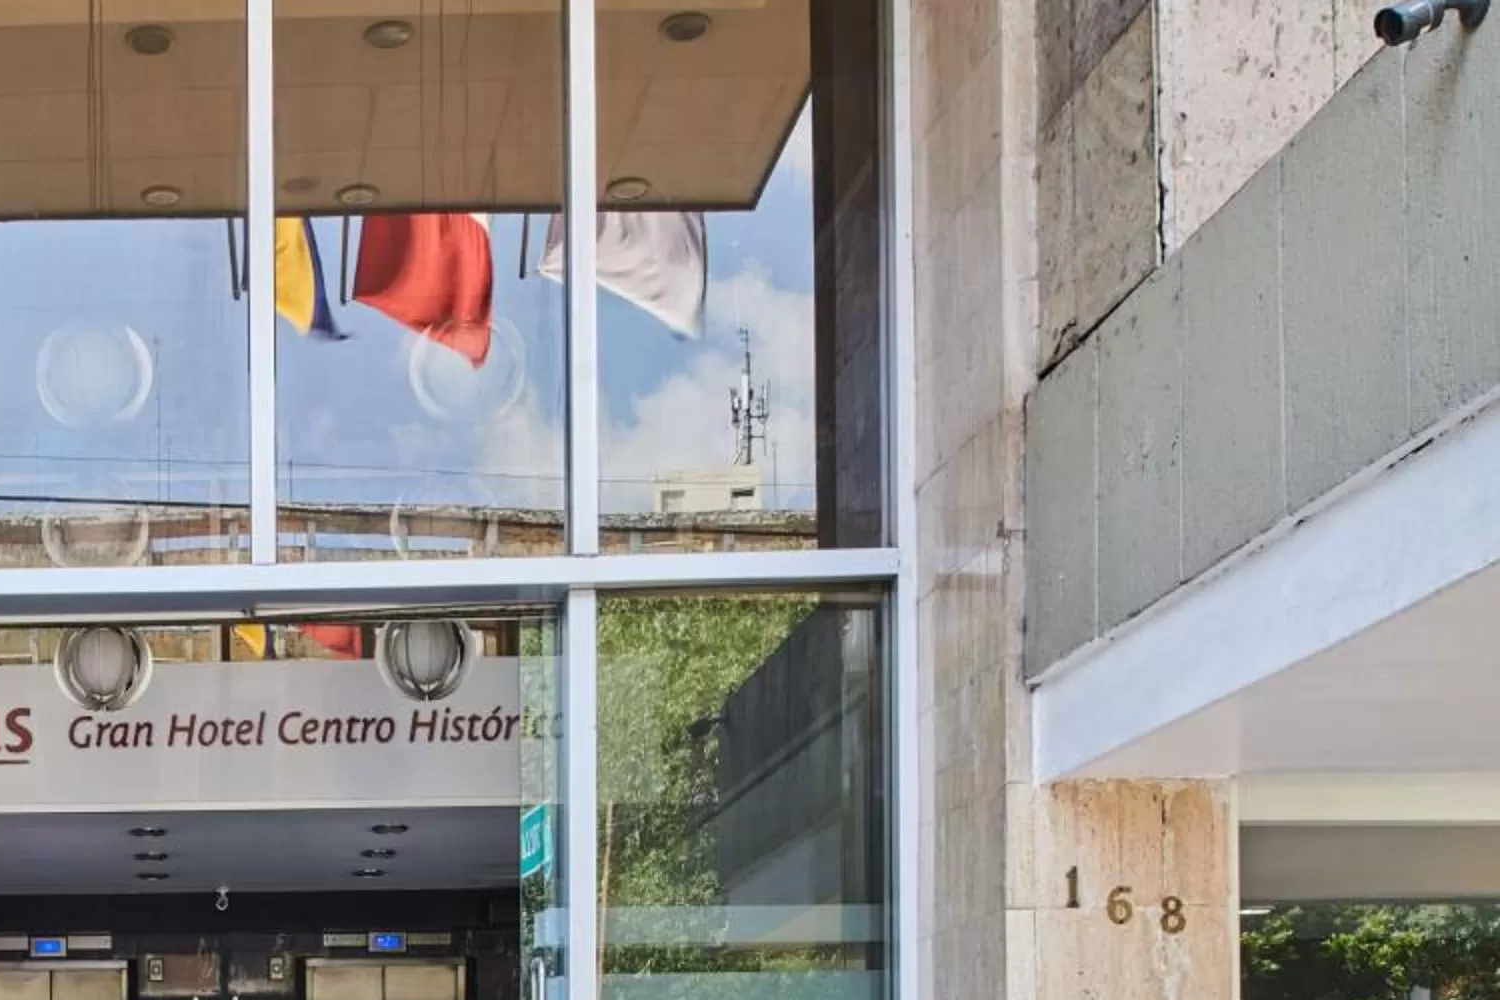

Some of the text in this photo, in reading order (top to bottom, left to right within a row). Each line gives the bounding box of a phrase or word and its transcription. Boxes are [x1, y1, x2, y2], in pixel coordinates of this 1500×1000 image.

[68, 715, 154, 749] Gran
[167, 710, 266, 747] Hotel
[277, 710, 396, 745] Centro
[1065, 865, 1187, 934] 168
